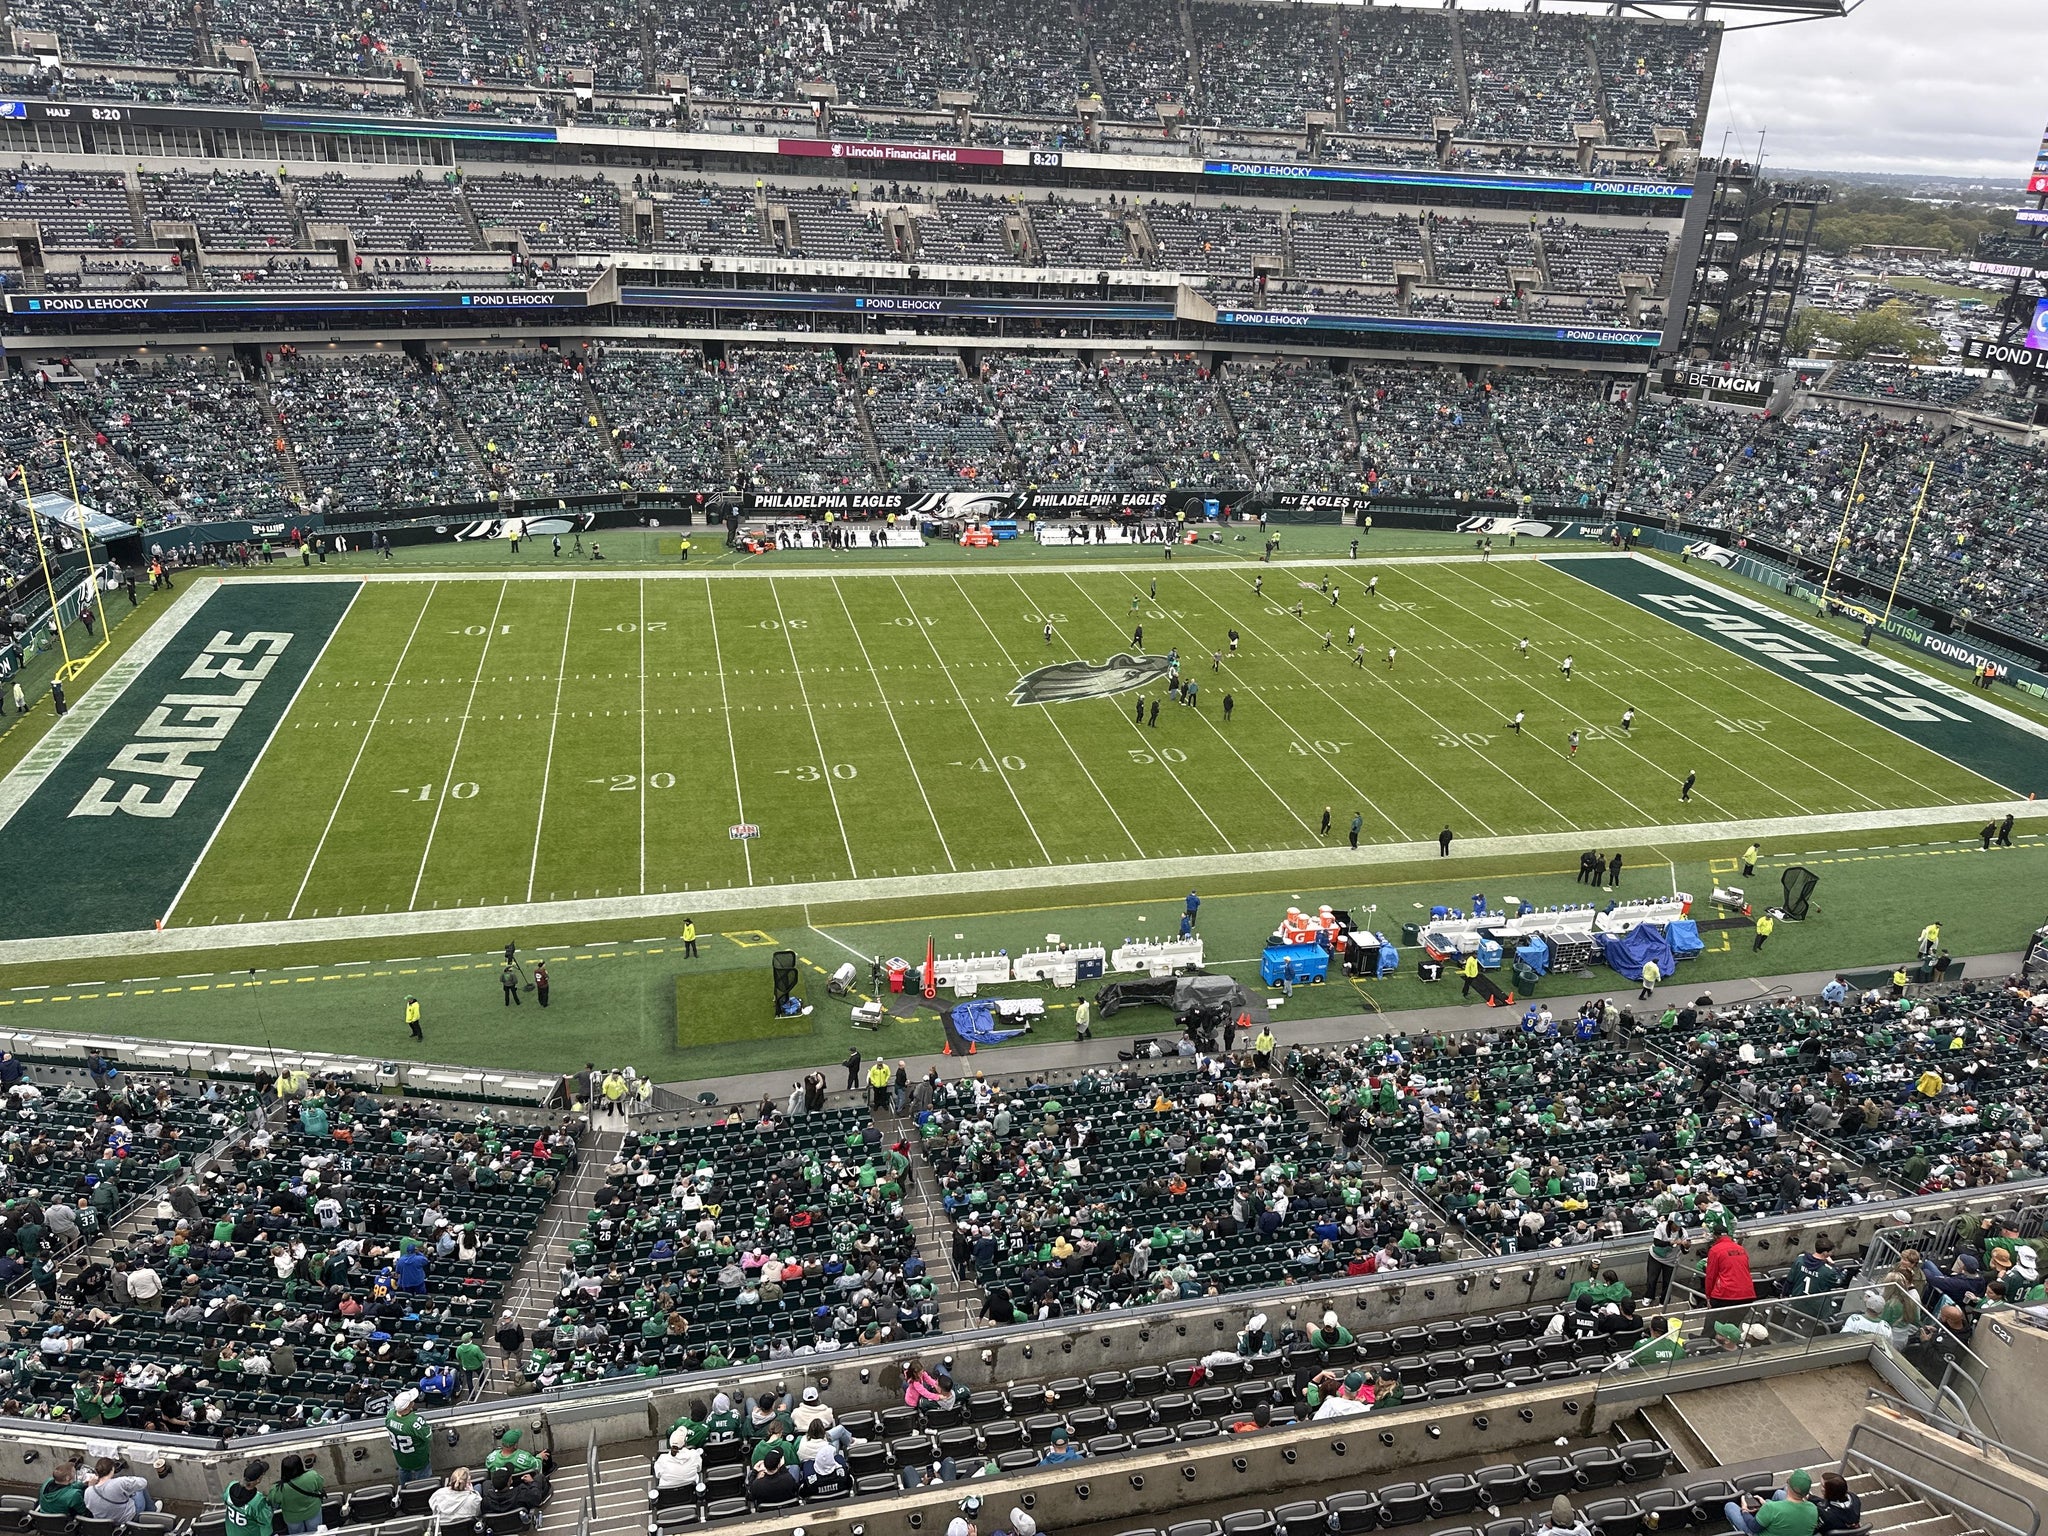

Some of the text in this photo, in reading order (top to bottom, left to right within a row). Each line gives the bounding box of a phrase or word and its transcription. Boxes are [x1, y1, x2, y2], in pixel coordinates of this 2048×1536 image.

[45, 108, 121, 120] HALF 8:20
[846, 146, 956, 161] Lincoln Financial Field
[1033, 153, 1059, 166] 8:20
[1231, 163, 1312, 177] POND LEHOCKY
[1594, 182, 1677, 195] POND LEHOCKY
[44, 298, 149, 310] POND LEHOCKY
[473, 295, 555, 305] POND LEHOCKY
[866, 299, 942, 310] POND LEHOCKY
[1236, 313, 1310, 325] POND LEHOCKY
[1567, 330, 1643, 342] POND LEHOCKY
[1985, 344, 2048, 370] POND L
[1688, 372, 1761, 394] BETMGM
[754, 494, 902, 508] PHILADELPHIA EAGLES
[1032, 493, 1167, 507] PHILADELPHIA EAGLES
[1280, 494, 1371, 509] FLY EAGLES FLY
[1378, 602, 1417, 612] 20
[1491, 598, 1532, 608] 10
[895, 616, 939, 627] 40
[1022, 613, 1069, 624] 50
[1145, 609, 1187, 620] 40
[464, 624, 514, 636] 10
[616, 622, 667, 633] 20
[760, 620, 808, 630] 30
[1879, 620, 1923, 644] AUTISM
[1923, 636, 2009, 676] FOUNDATION
[1638, 593, 1972, 722] EAGLES
[14, 661, 144, 777] INSPIRE CHANGE
[66, 630, 295, 819] EAGLES
[1714, 718, 1767, 734] 10
[1431, 733, 1490, 747] 30
[1289, 740, 1341, 756] 40
[1128, 748, 1188, 764] 50
[970, 755, 1027, 773] 40
[796, 763, 858, 782] 30
[609, 772, 677, 791] 20
[411, 781, 480, 802] 10
[1295, 932, 1305, 942] G
[244, 1095, 255, 1105] 12
[1585, 1177, 1596, 1187] 86
[81, 1214, 95, 1227] 33
[599, 1231, 611, 1241] 26
[1010, 1238, 1023, 1249] 20
[1803, 1276, 1812, 1295] 1
[1991, 1322, 2012, 1343] C21
[526, 1359, 540, 1373] 33
[389, 1418, 404, 1431] WHITE
[412, 1416, 426, 1431] 92
[715, 1419, 729, 1427] WHITE
[387, 1432, 415, 1454] 92
[227, 1505, 247, 1527] 26
